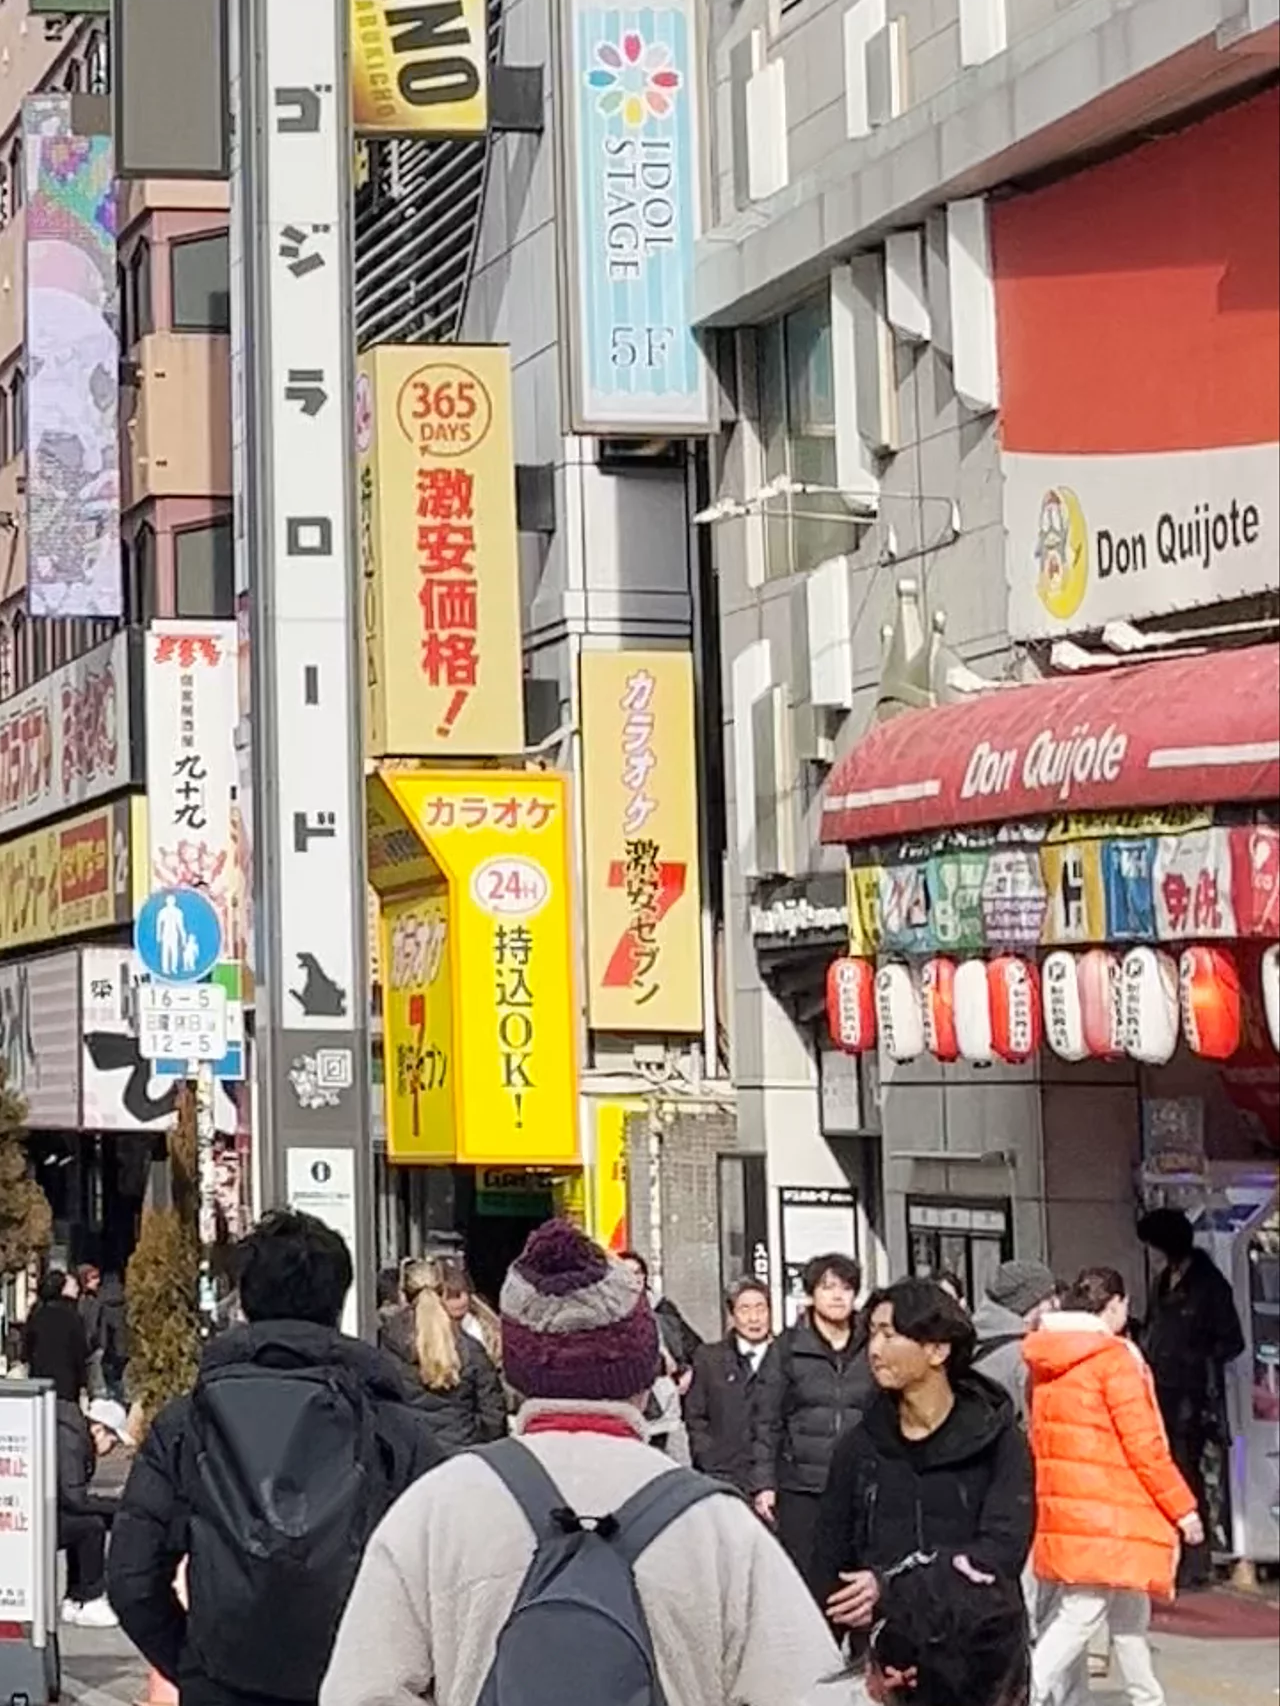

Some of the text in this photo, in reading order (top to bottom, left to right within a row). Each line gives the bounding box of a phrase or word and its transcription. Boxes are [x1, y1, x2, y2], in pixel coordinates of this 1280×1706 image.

[605, 138, 640, 281] STAGE
[639, 140, 675, 256] IDOL
[610, 326, 674, 367] 5F
[410, 381, 478, 422] 365
[419, 422, 472, 443] DAYS
[273, 81, 337, 853] ゴジラロード
[1095, 497, 1260, 582] Don Quijote
[172, 754, 207, 829] 九十九
[619, 670, 657, 836] カラオケ
[961, 722, 1129, 802] Don Quijote
[425, 794, 558, 832] カラオケ
[487, 869, 538, 901] 24H
